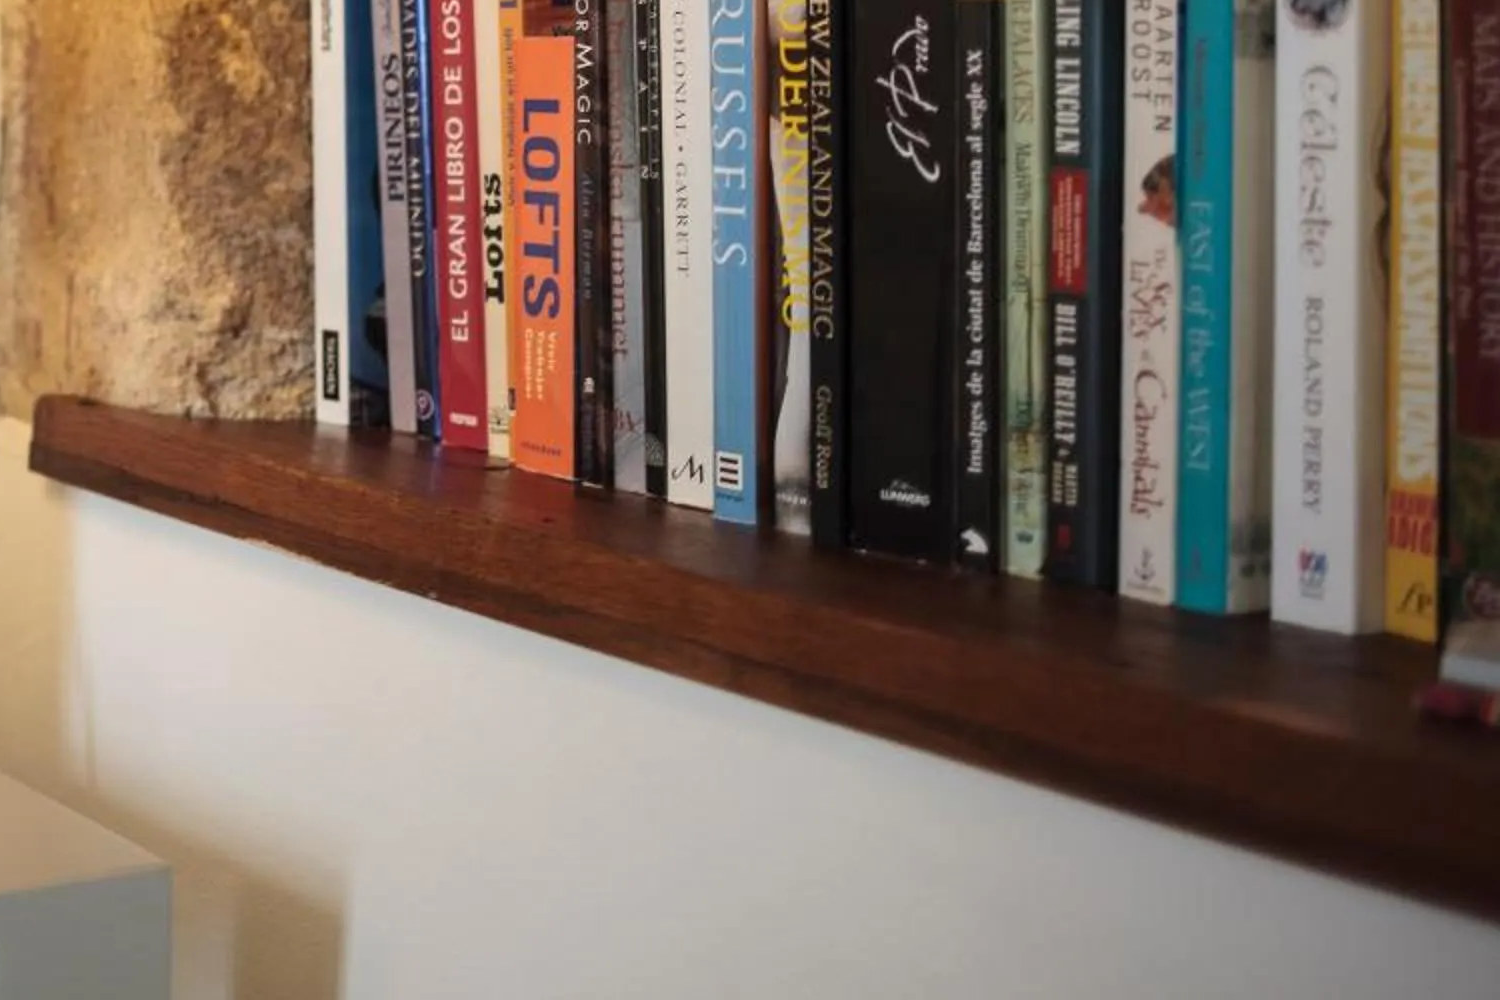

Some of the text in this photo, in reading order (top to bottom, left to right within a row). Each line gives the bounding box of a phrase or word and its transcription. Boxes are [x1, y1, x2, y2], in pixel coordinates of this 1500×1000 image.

[404, 91, 420, 140] DEL
[444, 65, 463, 106] DE
[575, 42, 596, 145] MAGIC
[670, 9, 690, 138] COLONIAL
[1009, 20, 1034, 125] PALACES
[1055, 58, 1082, 156] LINCOLN
[381, 52, 404, 202] PIRINEOS
[444, 116, 466, 201] LIBRO
[809, 56, 834, 218] ZEALAND
[406, 156, 427, 278] MUNDO
[483, 172, 505, 304] Lofts
[522, 98, 562, 320] LOFTS
[674, 163, 691, 278] GARRETT
[1187, 200, 1213, 273] EAST
[1472, 13, 1500, 361] MAPS AND HISTORY
[446, 213, 469, 302] GRAN
[811, 226, 835, 340] MAGIC
[965, 49, 989, 474] Imatges de la ciutat de Barcelona al segle XX
[1184, 284, 1215, 322] of
[451, 310, 469, 343] EL
[1055, 303, 1077, 346] BILL
[1186, 329, 1214, 380] the
[1054, 353, 1077, 444] O'REILLY
[1186, 387, 1212, 473] WEST
[1302, 295, 1325, 516] ROLAND PERRY
